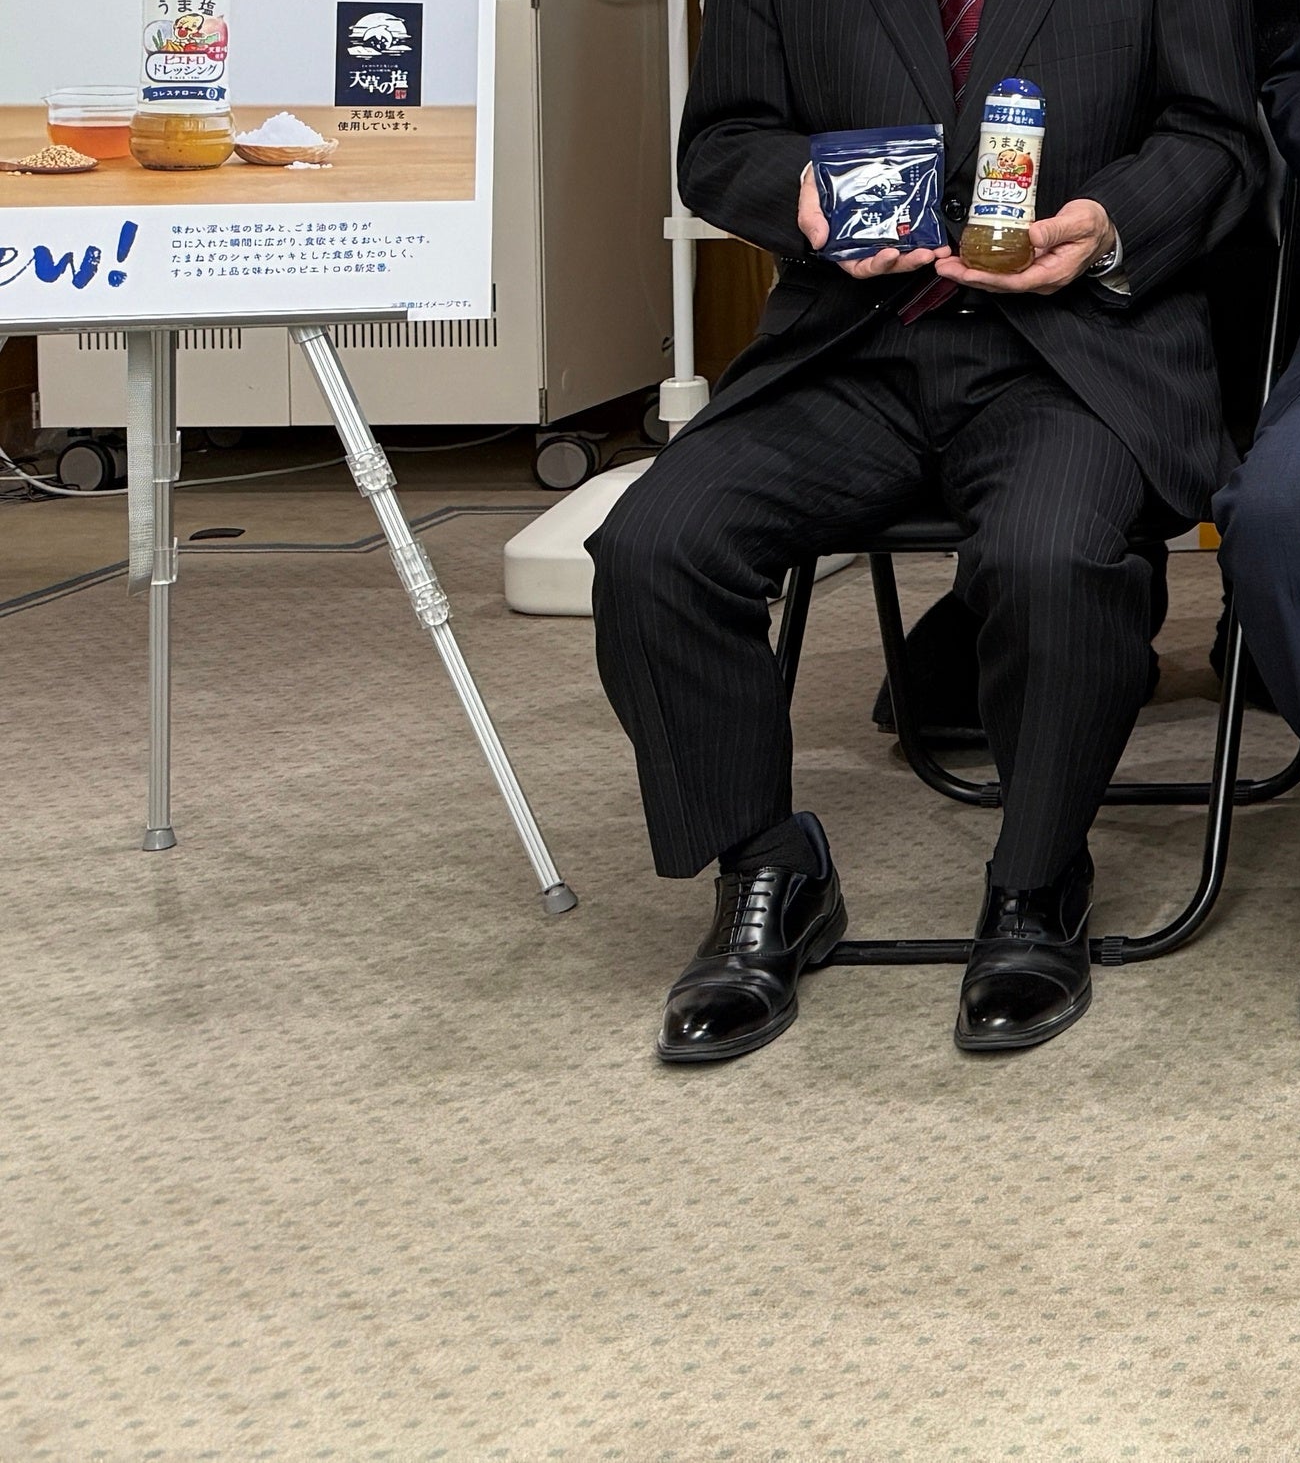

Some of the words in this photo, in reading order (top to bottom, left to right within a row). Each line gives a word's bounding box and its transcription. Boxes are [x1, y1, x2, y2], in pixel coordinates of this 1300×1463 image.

[164, 55, 206, 65] ピエトロ
[153, 64, 218, 76] ドレッシング
[349, 70, 409, 95] 天草の塩
[350, 109, 406, 120] 天草の塩を
[338, 121, 418, 132] 使用しています。
[988, 137, 1027, 152] うま塩
